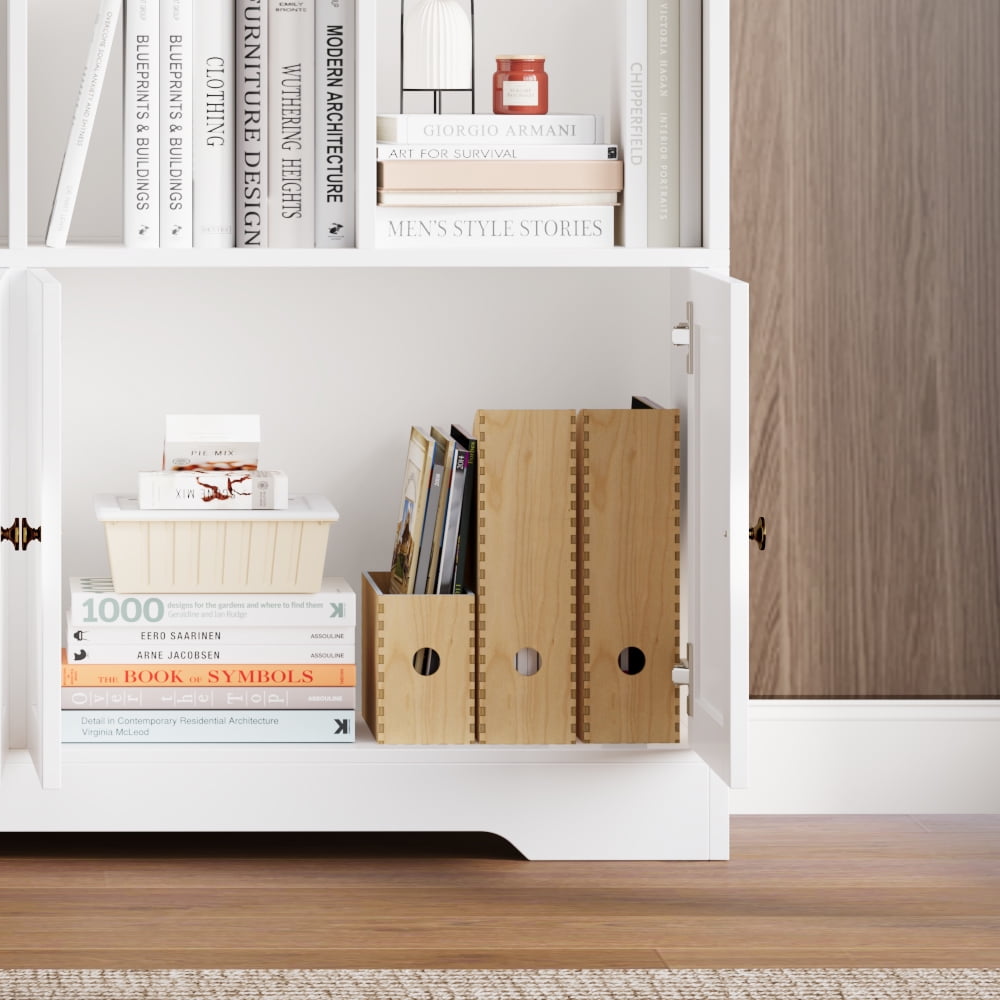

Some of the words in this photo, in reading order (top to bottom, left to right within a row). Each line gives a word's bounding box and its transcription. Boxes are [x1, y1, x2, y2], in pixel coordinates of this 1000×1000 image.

[659, 3, 669, 55] VICTORIA
[136, 34, 149, 120] BLUEPRINTS
[169, 34, 182, 120] BLUEPRINTS
[327, 25, 343, 87] MODERN
[659, 60, 669, 97] HAGAN
[206, 56, 224, 147] CLOTHING
[281, 63, 302, 150] WUTHERING
[630, 62, 643, 166] CHIPPERFIELD
[136, 124, 149, 132] &
[169, 124, 182, 132] &
[327, 90, 343, 203] ARCHITECTURE
[423, 124, 499, 137] GIORGIO
[506, 124, 577, 137] ARMANI
[659, 113, 669, 160] INTERIOR
[136, 138, 149, 210] BUILDINGS
[169, 138, 182, 210] BUILDINGS
[389, 149, 416, 159] ART
[420, 149, 449, 159] FOR
[454, 149, 517, 159] SURVIVAL
[244, 151, 260, 246] DESIGN
[281, 158, 302, 219] HEIGHTS
[659, 165, 669, 221] PORTRAITS
[388, 220, 447, 237] MEN'S
[453, 220, 514, 237] STYLE
[519, 220, 603, 237] STORIES
[82, 597, 165, 623] 1000
[167, 601, 193, 610] designs
[194, 601, 204, 610] for
[206, 601, 217, 610] the
[218, 601, 245, 610] gardens
[246, 601, 258, 610] and
[260, 601, 281, 610] where
[283, 601, 290, 610] to
[291, 601, 304, 610] find
[306, 601, 324, 610] them
[137, 651, 164, 659] ARNE
[167, 651, 220, 659] JACOBSEN
[141, 632, 166, 640] EERO
[170, 632, 221, 640] SAARINEN
[124, 670, 183, 683] BOOK
[208, 670, 314, 683] SYMBOLS
[81, 717, 105, 725] Detail
[108, 717, 115, 725] in
[117, 717, 176, 725] Contemporary
[180, 717, 226, 725] Residential
[229, 717, 279, 725] Architecture
[82, 729, 113, 738] Virginia
[116, 729, 150, 738] McLeod
